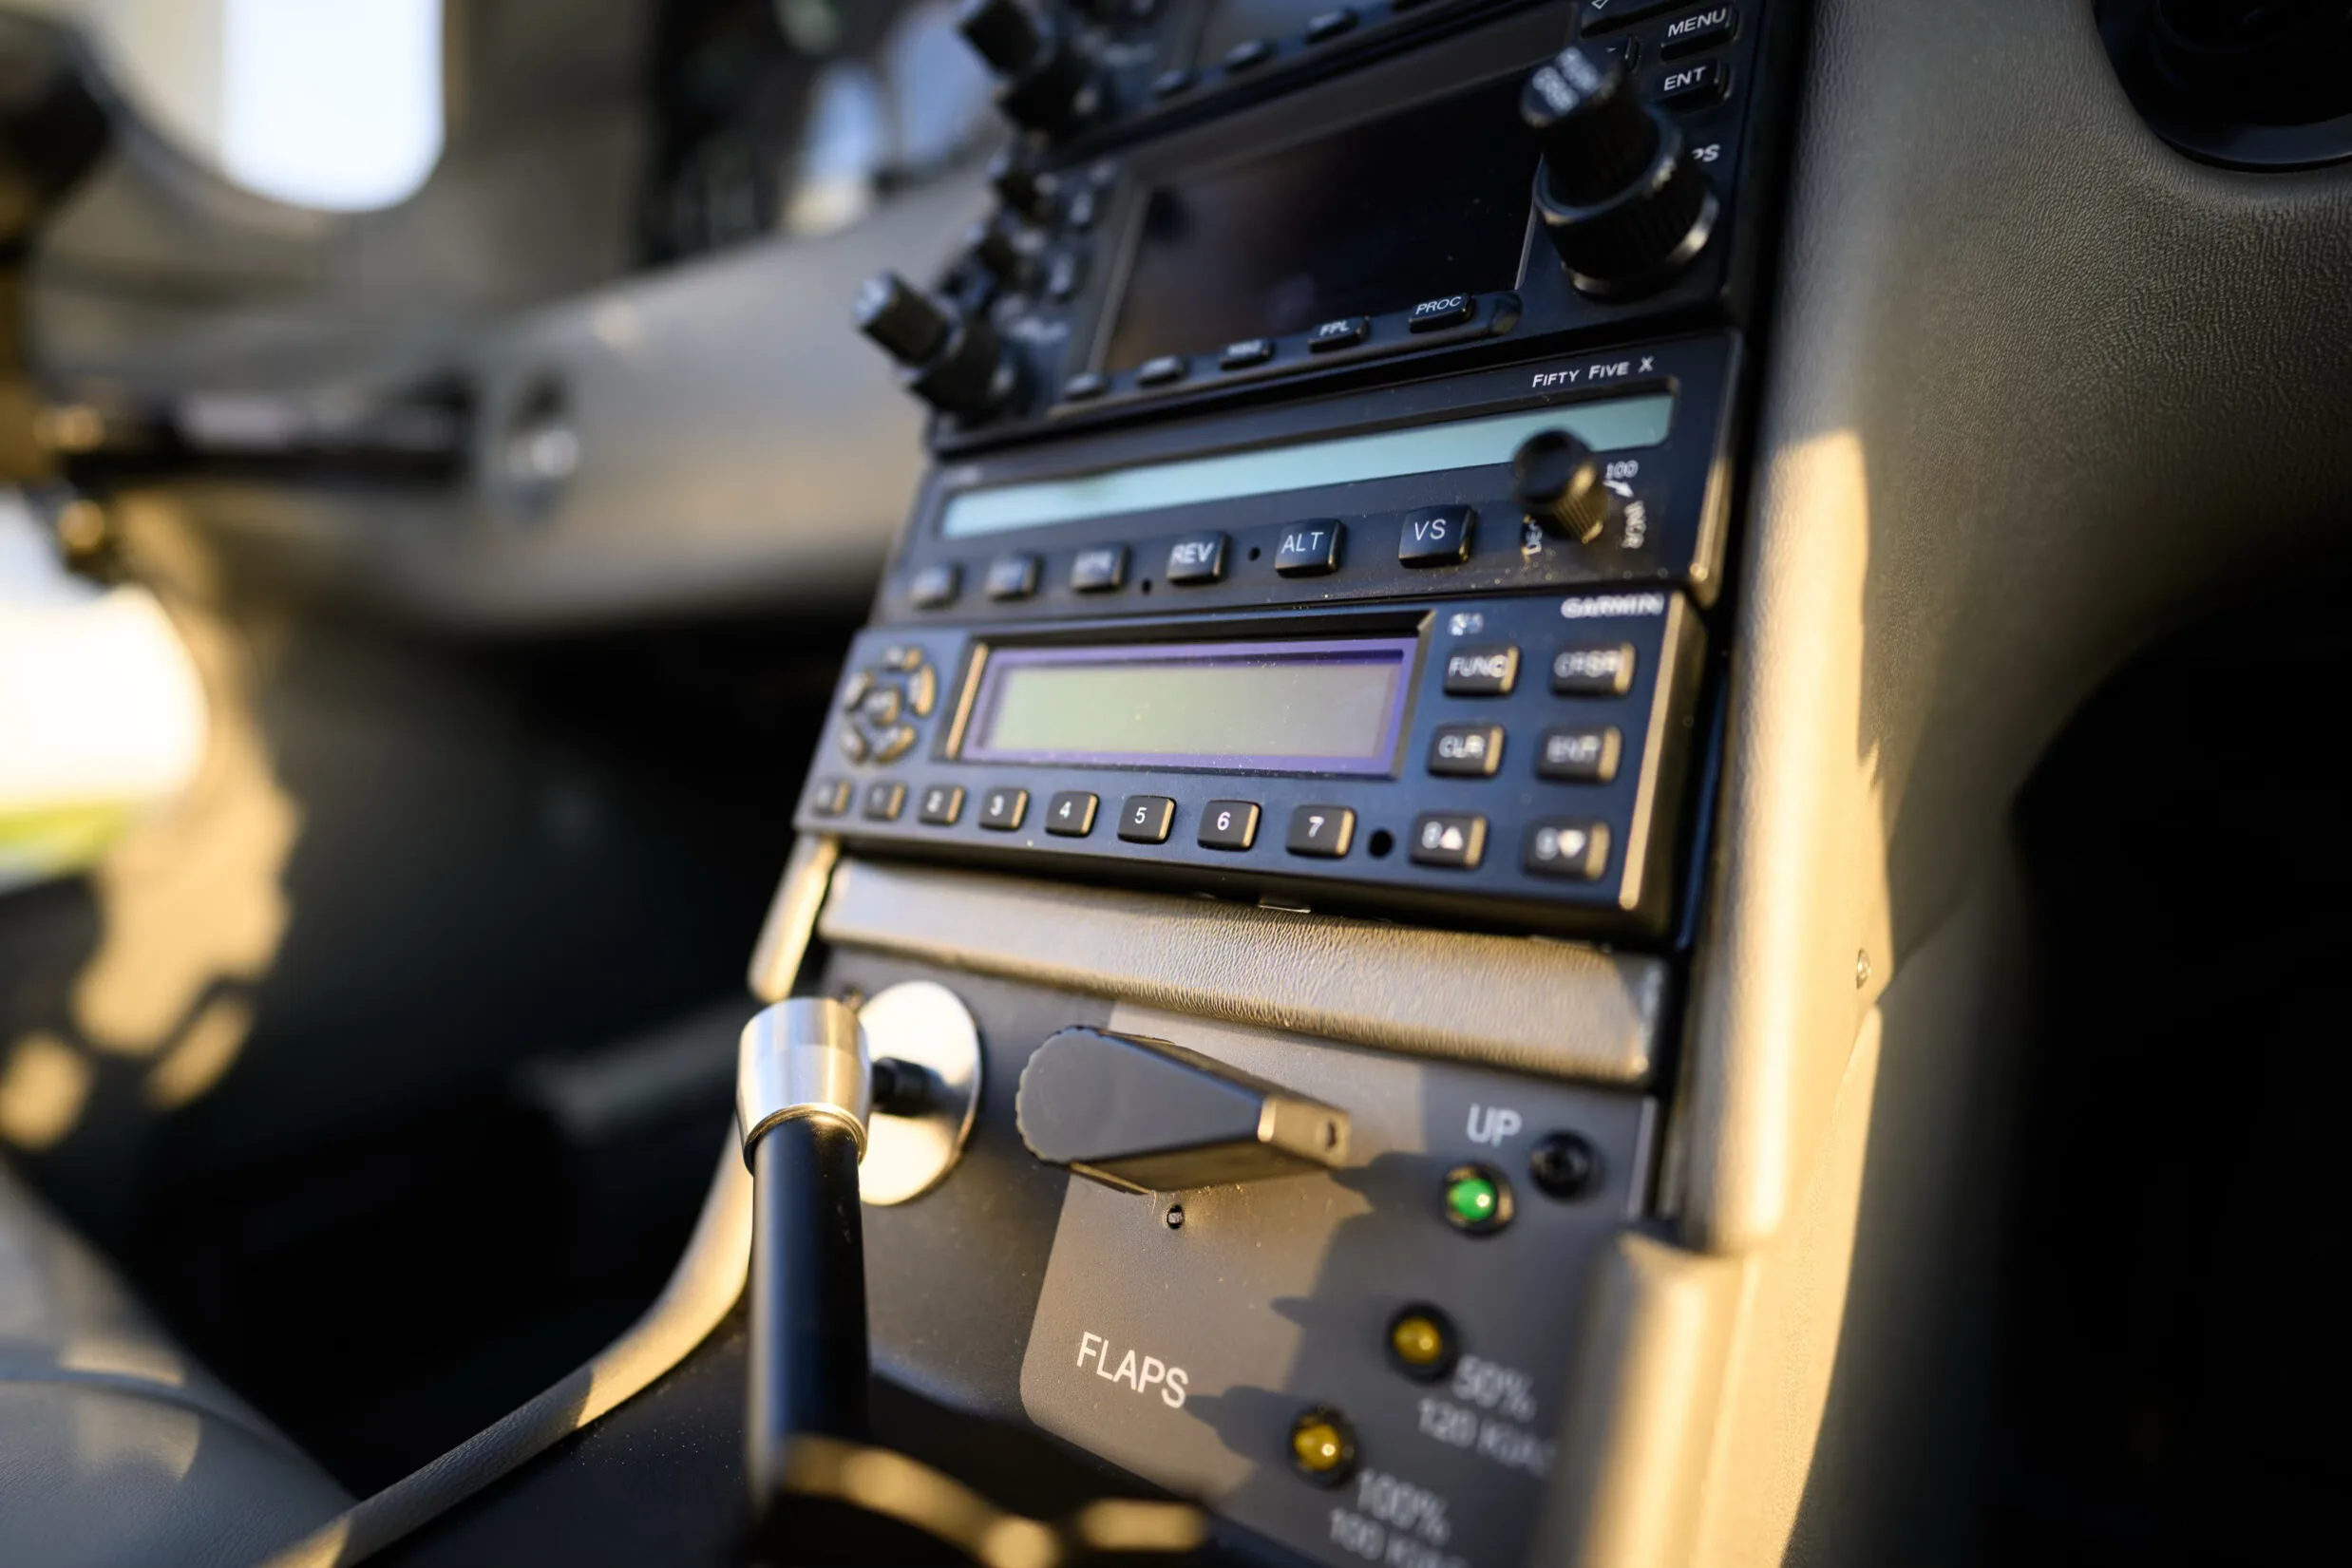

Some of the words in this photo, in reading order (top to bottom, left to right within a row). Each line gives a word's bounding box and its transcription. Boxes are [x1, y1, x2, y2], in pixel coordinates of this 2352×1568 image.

[1667, 8, 1727, 37] MENU
[1663, 66, 1707, 91] ENT
[1415, 296, 1462, 315] PROC
[1532, 368, 1580, 387] FIFTY
[1588, 361, 1630, 380] FIVE
[1639, 356, 1654, 373] X
[1414, 519, 1447, 541] VS
[1171, 542, 1214, 564] REV
[1281, 532, 1324, 554] ALT
[1449, 654, 1508, 678] FUNC
[1058, 801, 1073, 819] 4
[1134, 807, 1147, 824] 5
[1216, 811, 1231, 831] 6
[1308, 815, 1324, 838] 7
[1467, 1103, 1523, 1147] UP
[1076, 1331, 1188, 1408] FLAPS
